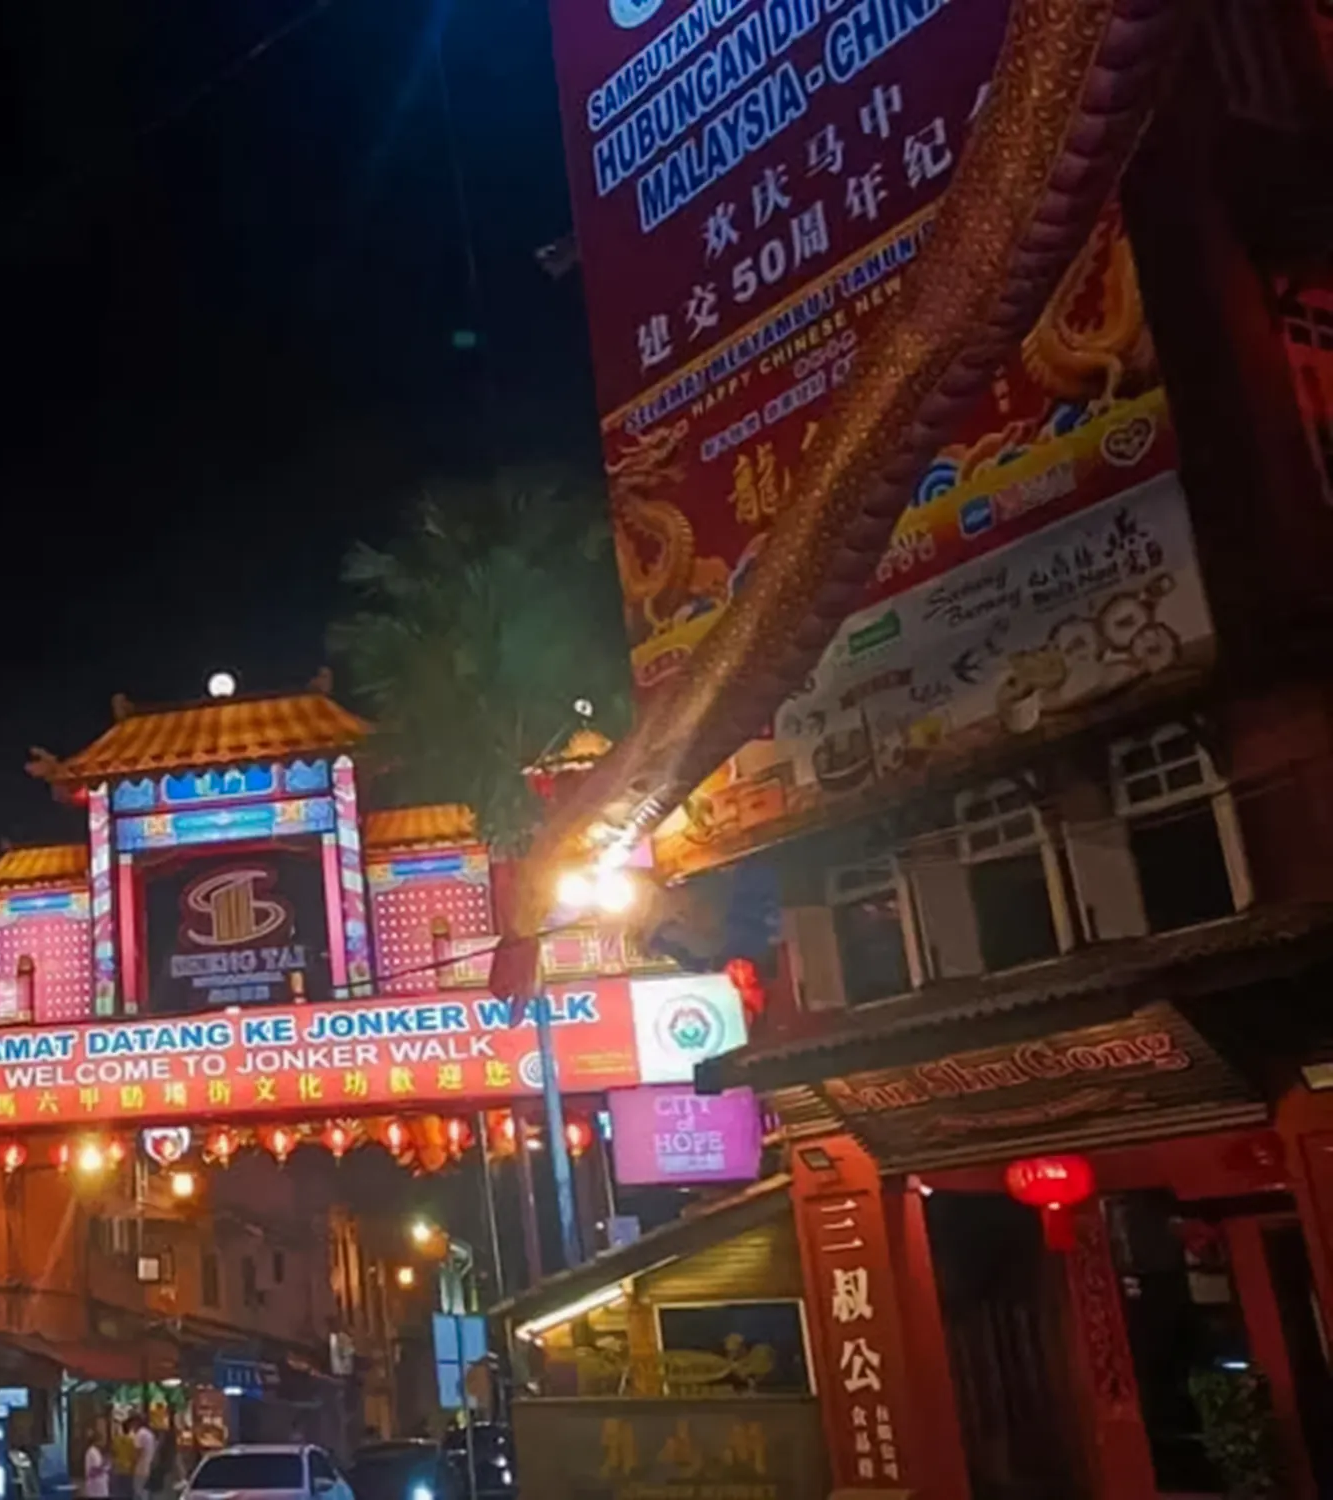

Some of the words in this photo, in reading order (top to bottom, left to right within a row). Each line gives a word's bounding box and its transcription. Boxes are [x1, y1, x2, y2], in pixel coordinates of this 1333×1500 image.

[587, 8, 709, 130] SAMBUTAN
[593, 12, 766, 196] HUBUNGAN
[638, 62, 807, 233] MALAYSIA
[825, 0, 953, 83] CHIN
[836, 233, 919, 298] TAHUN
[691, 369, 751, 419] HAPPY
[759, 309, 847, 376] CHINESE
[854, 275, 903, 317] NEW
[5, 1058, 172, 1089] WELCOME
[181, 1053, 226, 1080] TO
[236, 1045, 380, 1076] JONKER
[389, 1034, 496, 1065] WALK
[87, 1021, 232, 1058] DATANG
[243, 1017, 297, 1046] KE
[307, 1003, 467, 1042] JONKER
[653, 1095, 713, 1116] CITY
[653, 1129, 727, 1154] HOPE
[820, 1199, 883, 1393] 三叔公
